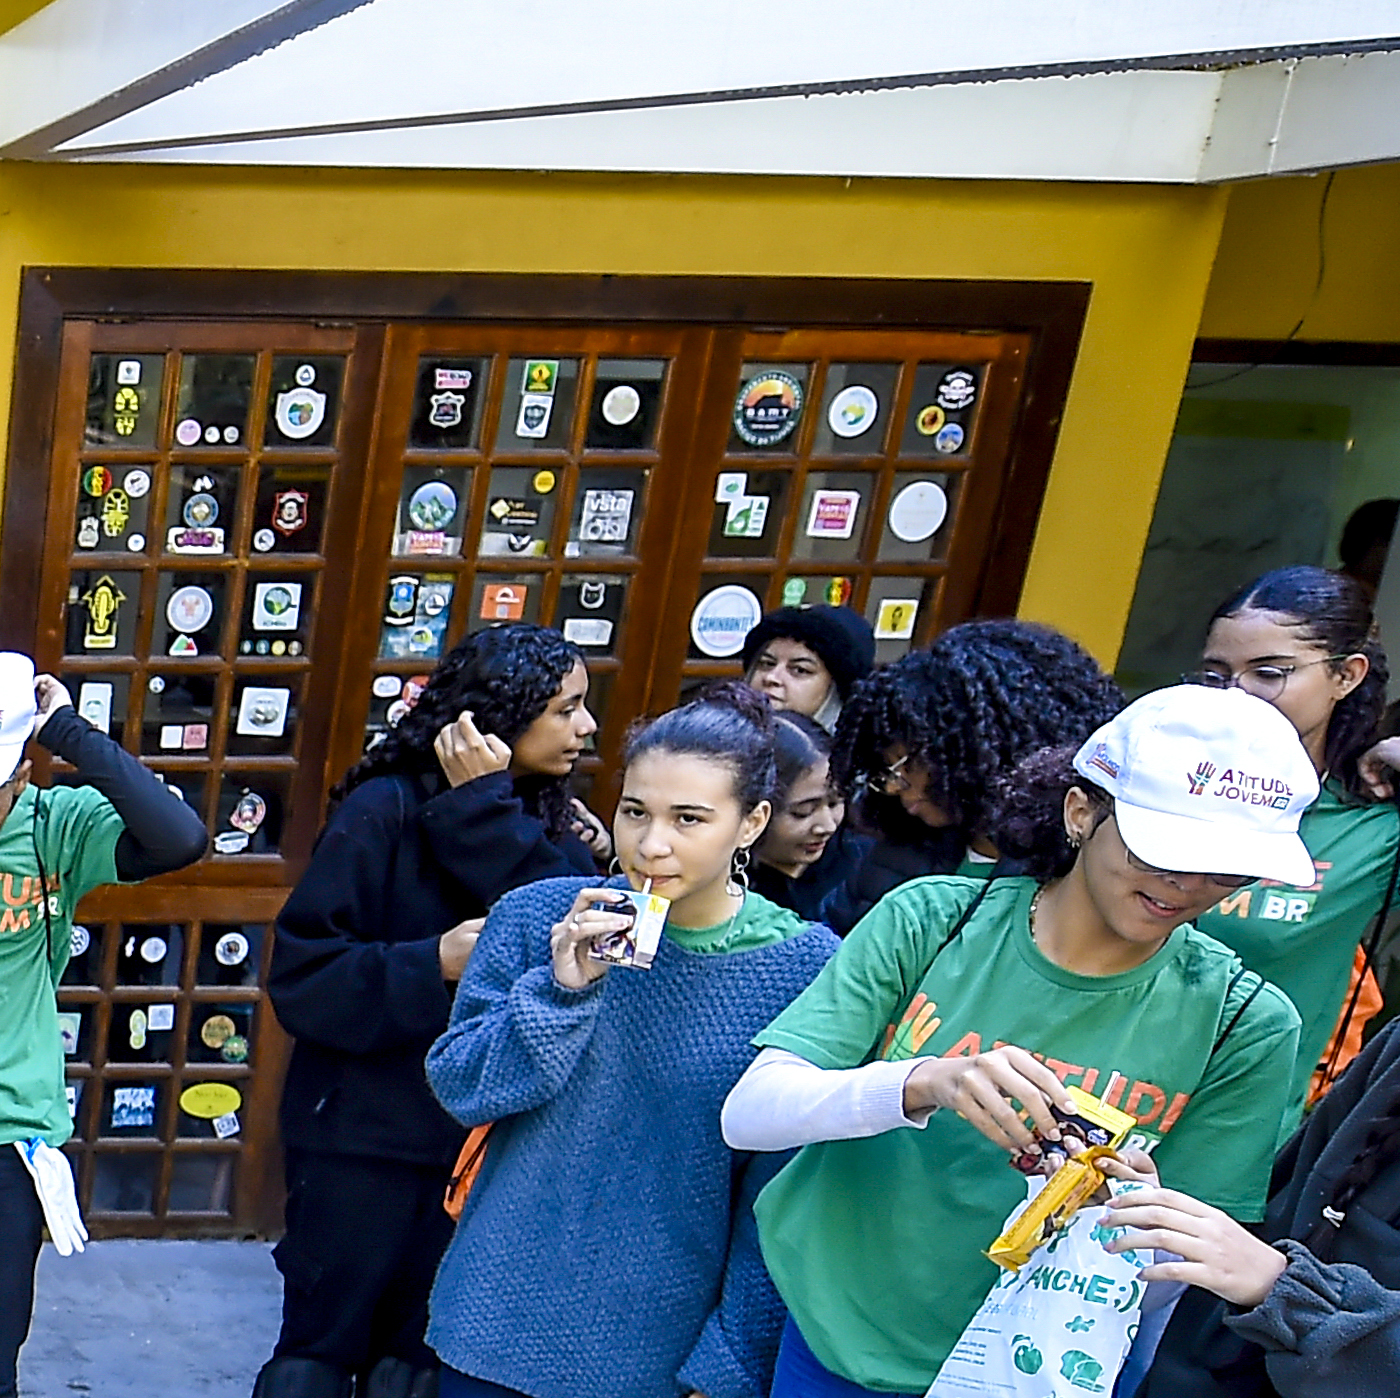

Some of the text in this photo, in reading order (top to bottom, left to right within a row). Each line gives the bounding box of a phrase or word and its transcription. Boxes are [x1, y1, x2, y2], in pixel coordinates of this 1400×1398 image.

[1214, 785, 1273, 807] JOVEM
[1219, 769, 1294, 796] ATITUDE
[1266, 894, 1309, 922] BR
